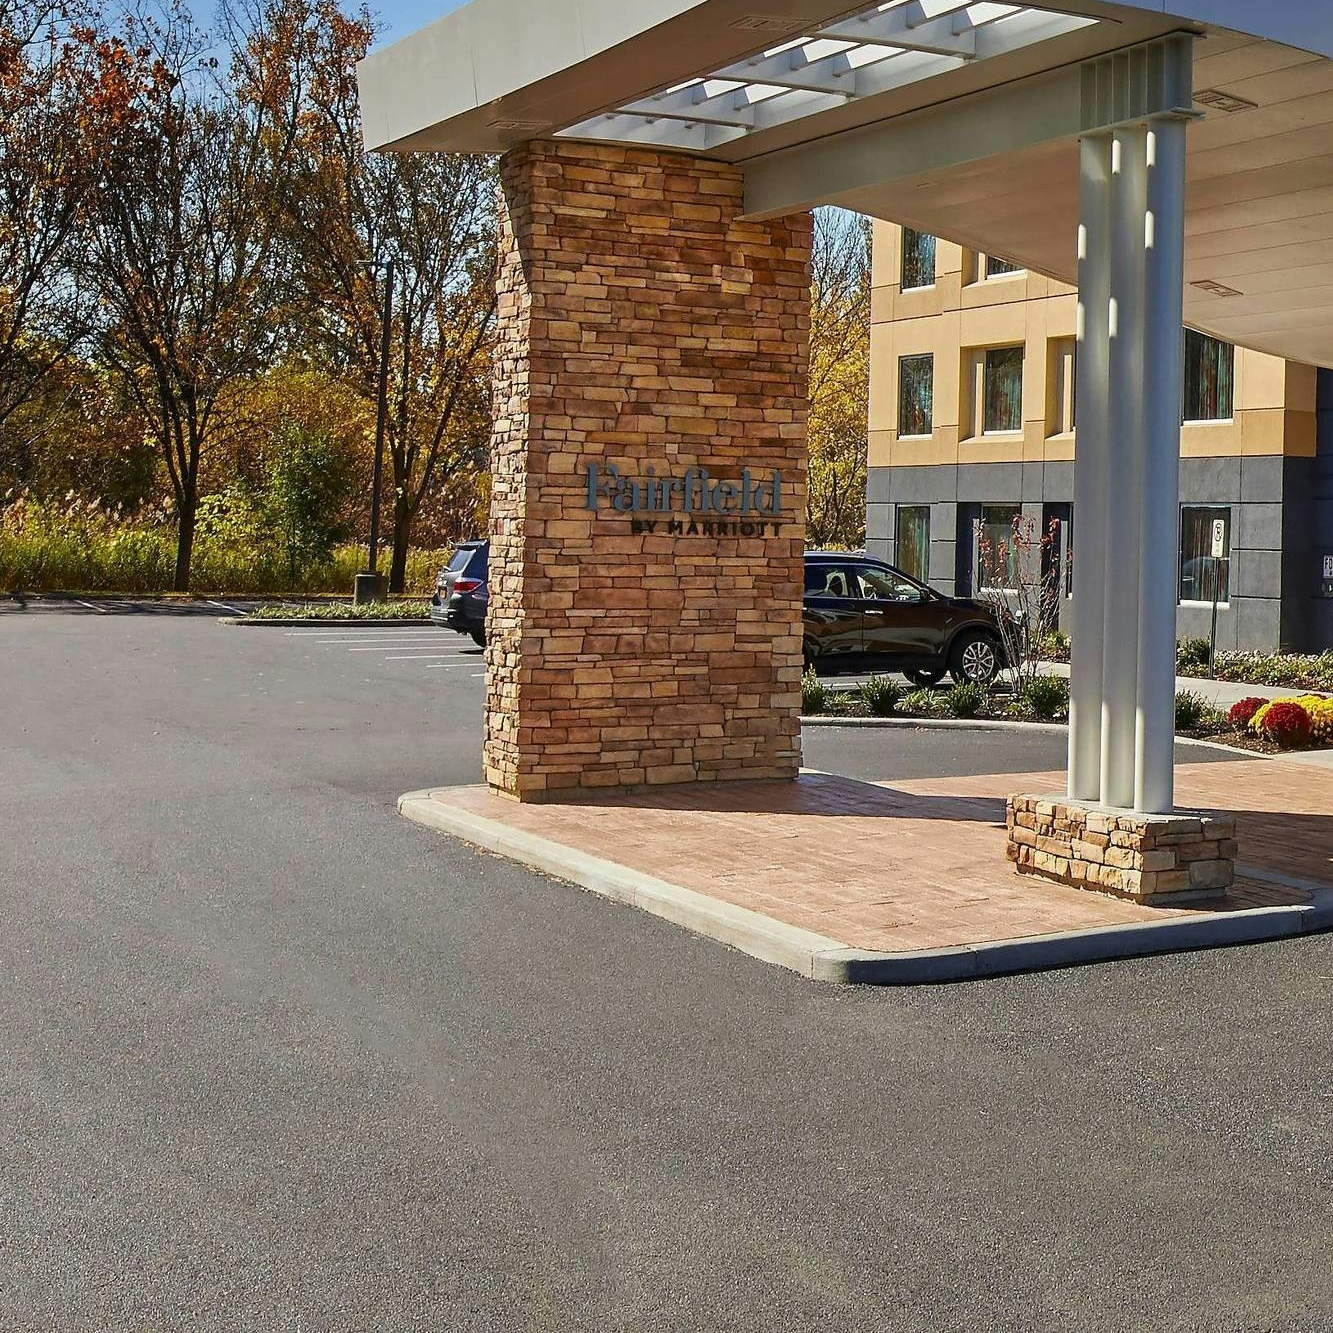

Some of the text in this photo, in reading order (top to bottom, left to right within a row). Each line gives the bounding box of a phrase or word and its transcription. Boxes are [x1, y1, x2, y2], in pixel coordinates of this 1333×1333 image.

[586, 463, 783, 515] Fairfield
[632, 521, 782, 536] BY MARRIOTT
